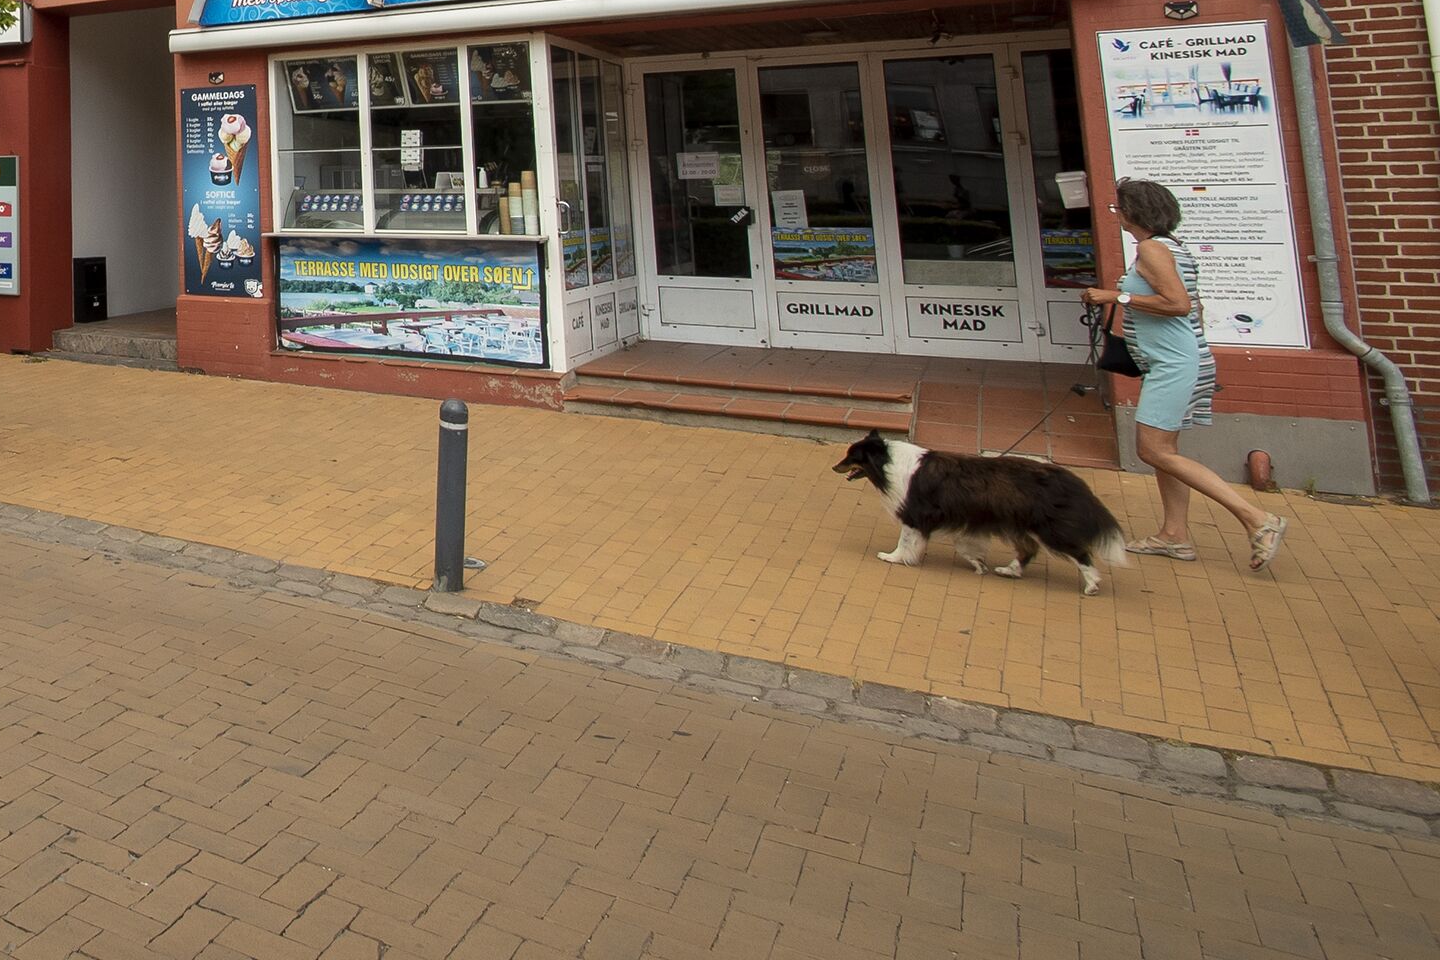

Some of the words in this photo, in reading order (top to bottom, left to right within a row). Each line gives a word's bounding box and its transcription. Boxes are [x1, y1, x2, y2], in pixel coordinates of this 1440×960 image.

[1139, 38, 1174, 50] CAFÉ
[1185, 35, 1256, 47] GRILLMAD
[1150, 49, 1213, 61] KINESISK
[1215, 48, 1247, 58] MAD
[191, 91, 245, 102] GAMMELDAGS
[205, 190, 236, 199] SOFTICE
[295, 260, 356, 278] TERRASSE
[360, 262, 388, 279] MED
[391, 263, 439, 281] UDSIGT
[443, 264, 479, 283] OVER
[483, 266, 524, 285] SØEN
[786, 303, 874, 318] GRILLMAD
[919, 303, 1005, 318] KINESISK
[572, 312, 584, 330] CAFÉ
[942, 318, 986, 332] MAD
